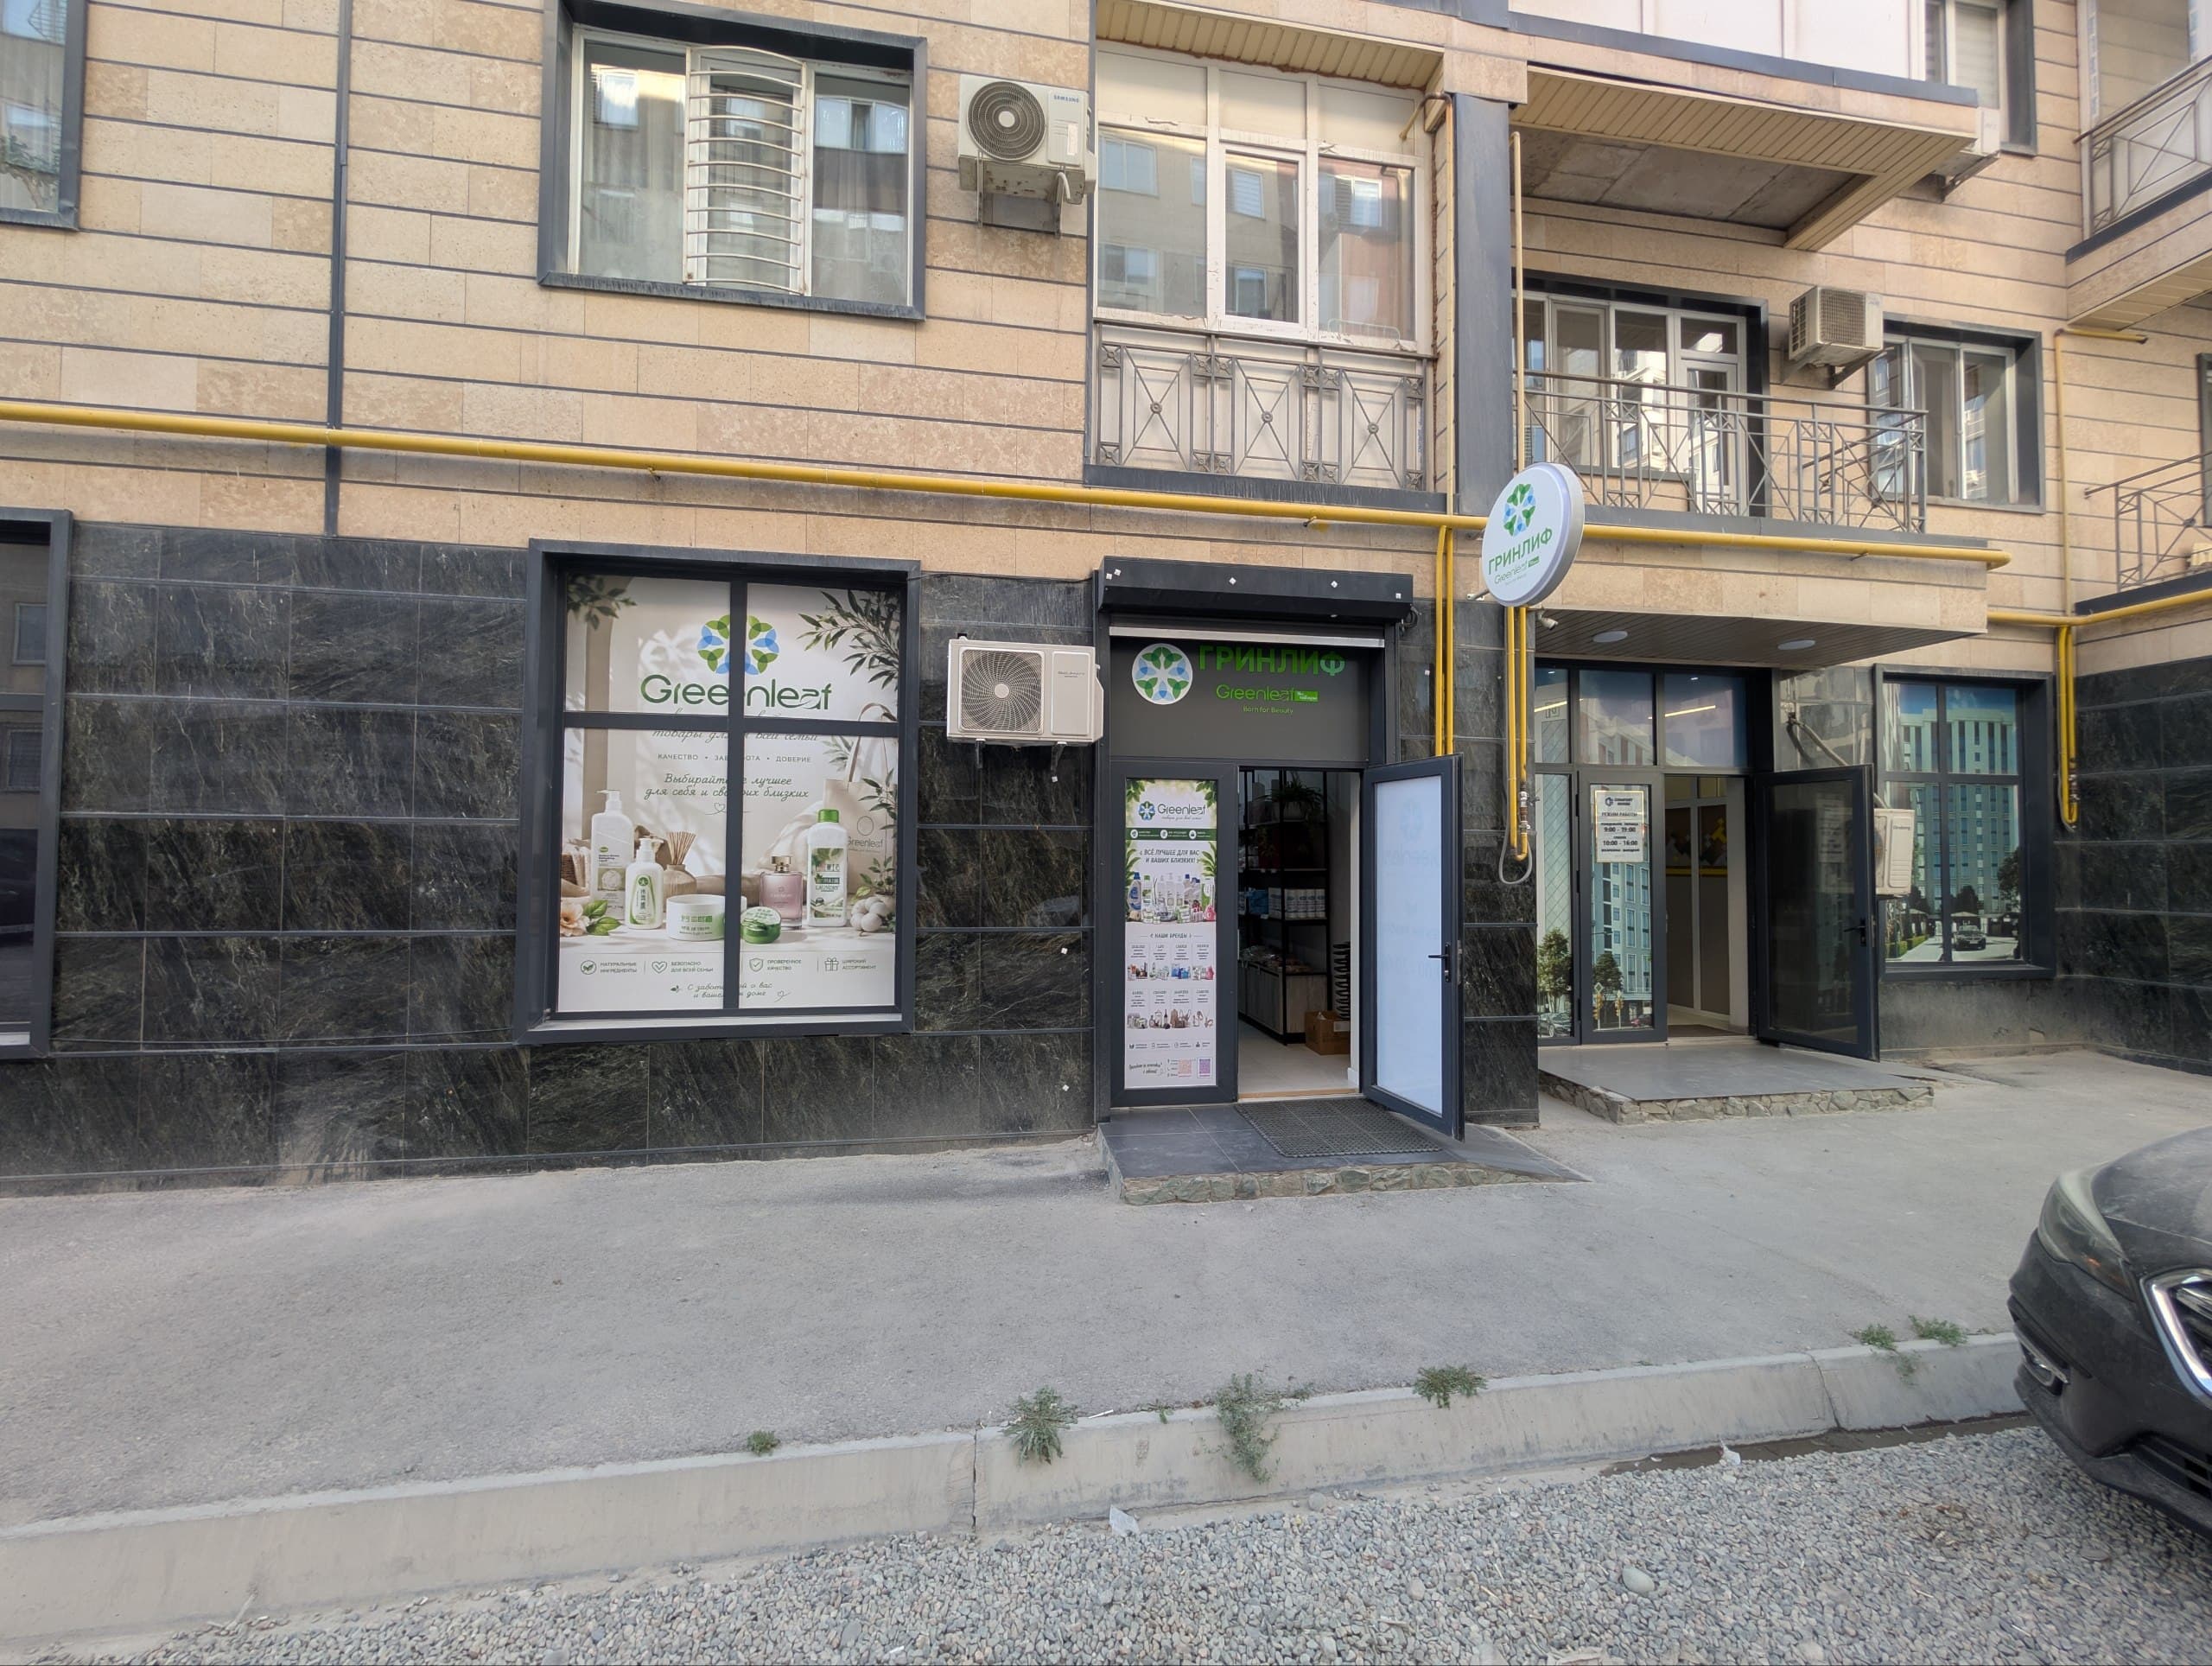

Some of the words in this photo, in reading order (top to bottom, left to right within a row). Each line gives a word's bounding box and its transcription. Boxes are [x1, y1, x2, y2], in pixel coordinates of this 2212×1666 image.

[1053, 94, 1079, 103] SAMSUNG
[1488, 528, 1553, 575] ГРИНЛИФ
[1198, 645, 1346, 677] ГРИНЛИФ
[640, 674, 833, 710] Greenleaf
[1216, 684, 1294, 702] Greenleaf
[775, 755, 811, 764] ДОВЕРИЕ
[751, 777, 792, 786] лучшее
[644, 787, 668, 800] для
[672, 785, 697, 797] себя
[763, 785, 810, 800] близких
[1157, 803, 1206, 816] Greenleaf
